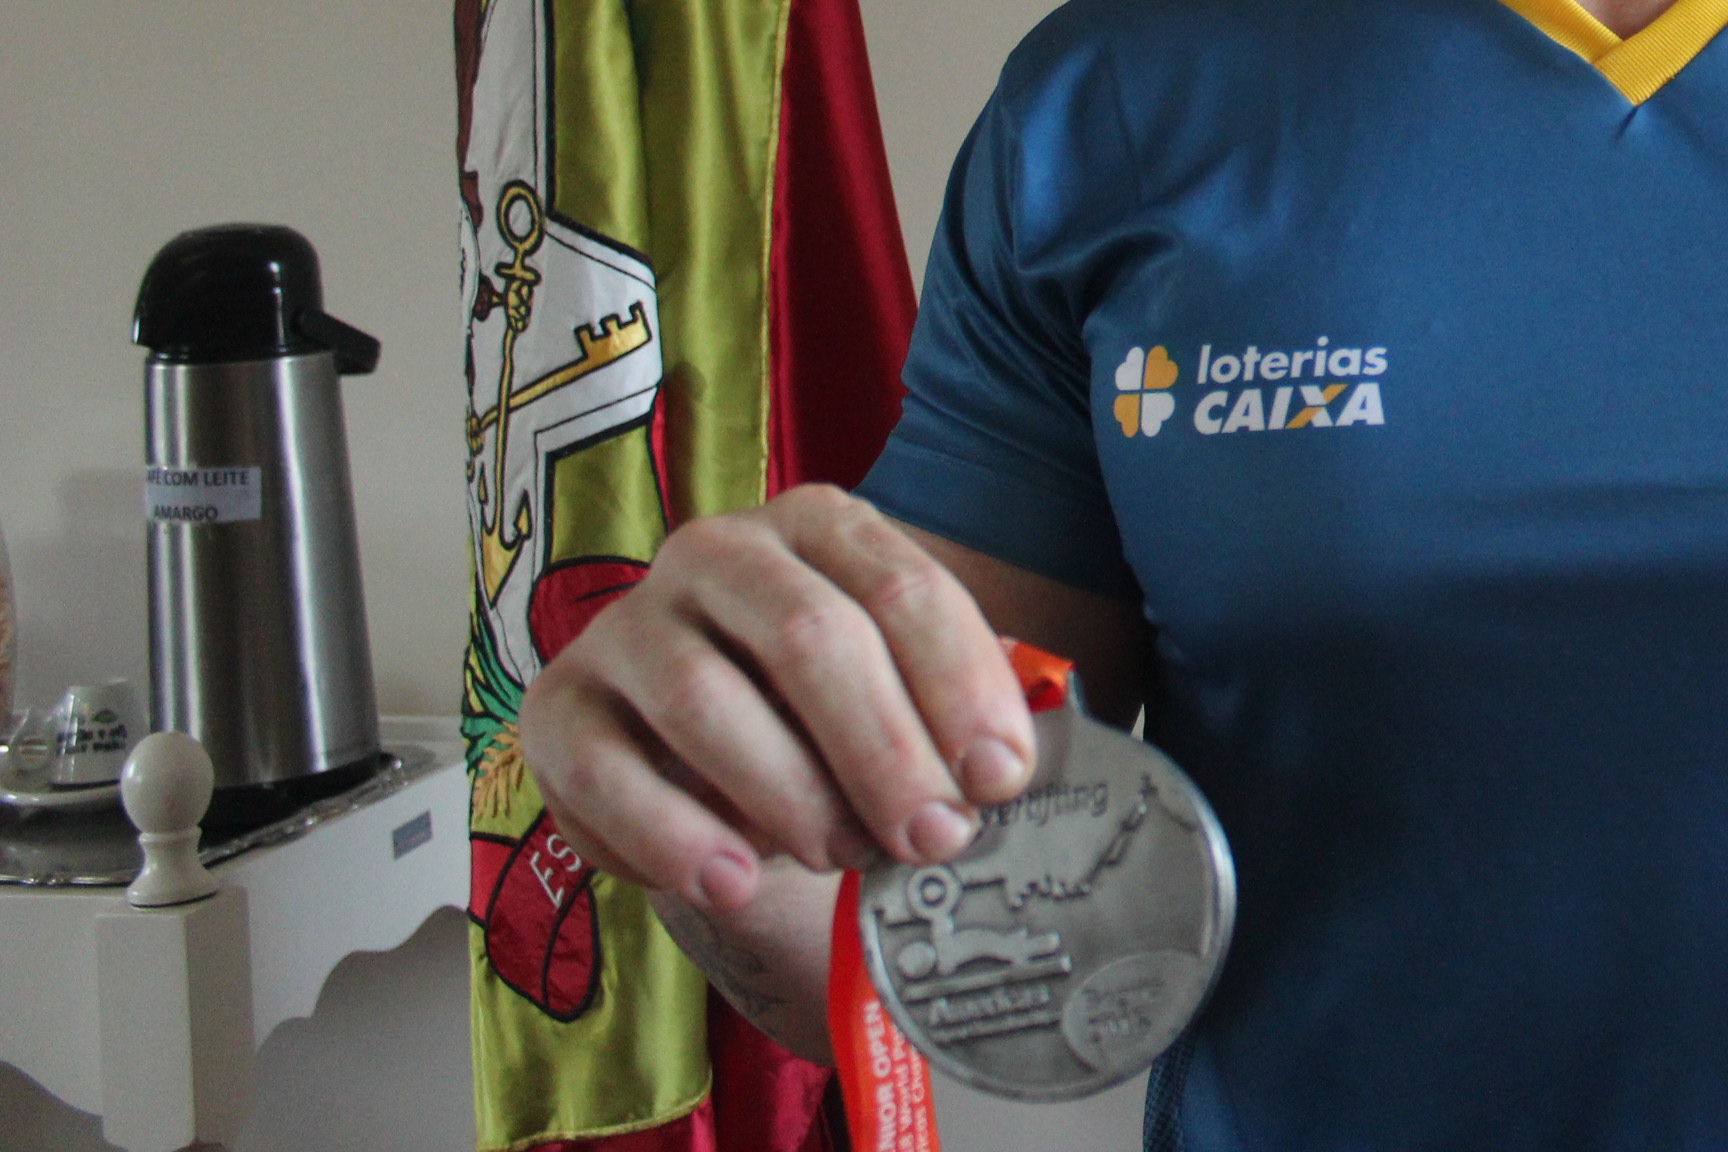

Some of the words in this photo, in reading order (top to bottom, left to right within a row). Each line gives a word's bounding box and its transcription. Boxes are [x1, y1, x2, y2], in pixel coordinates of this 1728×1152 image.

[1197, 336, 1388, 384] loterias
[1193, 381, 1386, 435] CAIXA
[163, 471, 198, 486] COM
[204, 470, 249, 486] LEITE
[153, 504, 218, 521] AMARGO
[864, 1001, 892, 1079] OPEN
